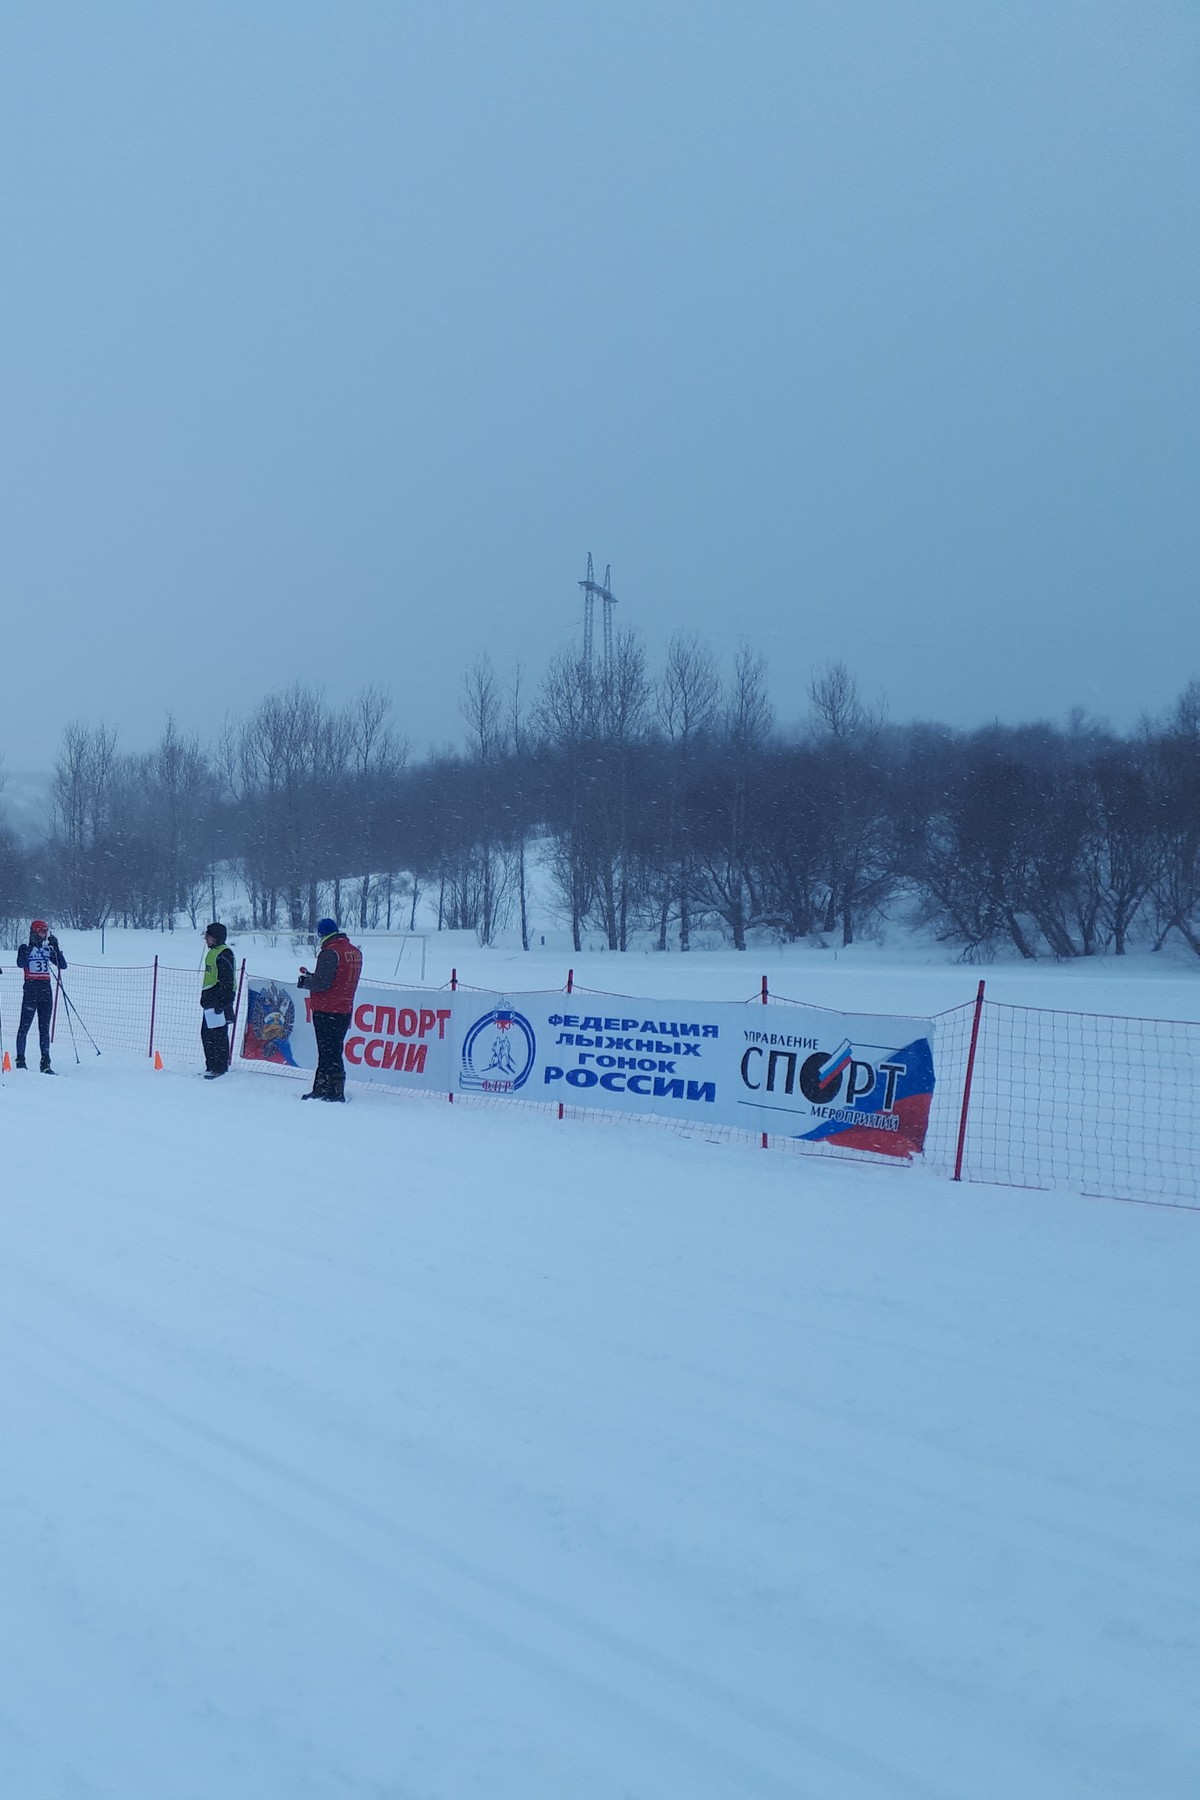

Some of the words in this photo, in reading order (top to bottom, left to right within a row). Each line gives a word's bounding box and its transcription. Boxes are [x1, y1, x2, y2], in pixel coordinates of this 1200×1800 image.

[36, 961, 48, 972] 33
[548, 1014, 719, 1038] ФЕДЕРАЦИЯ
[556, 1033, 702, 1057] ЛЫЖНЫХ
[744, 1030, 819, 1050] УПРАВЛЕНИЕ
[345, 1036, 428, 1073] ССИИ
[578, 1052, 678, 1074] ГОНОК
[544, 1066, 717, 1102] РОССИИ
[740, 1046, 906, 1110] СПОРТ
[810, 1106, 900, 1131] МЕРОПРИЯТИЙ
